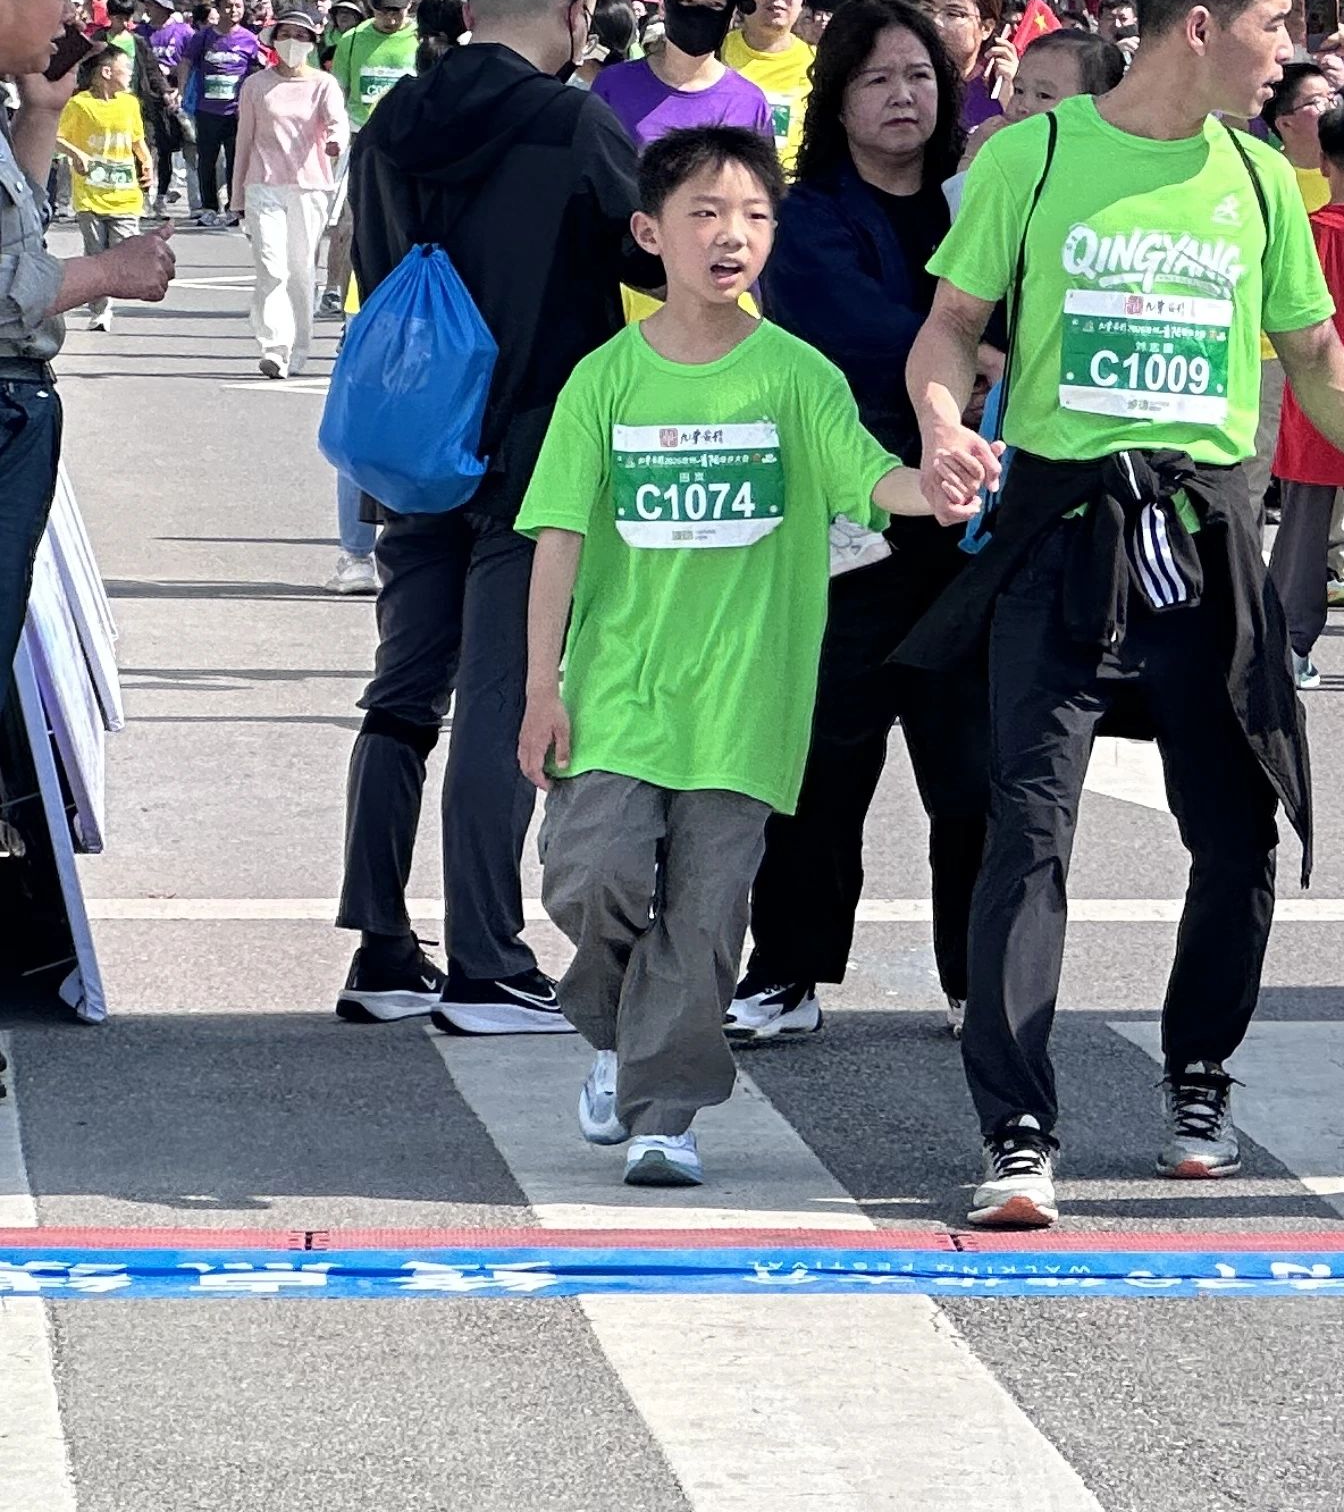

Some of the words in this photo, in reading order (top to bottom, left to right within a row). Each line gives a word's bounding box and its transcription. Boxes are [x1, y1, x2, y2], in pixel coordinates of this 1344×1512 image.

[1062, 222, 1246, 299] QINGYANG
[1090, 349, 1210, 395] C1009
[636, 482, 756, 520] C1074
[935, 1264, 1091, 1274] WALKING
